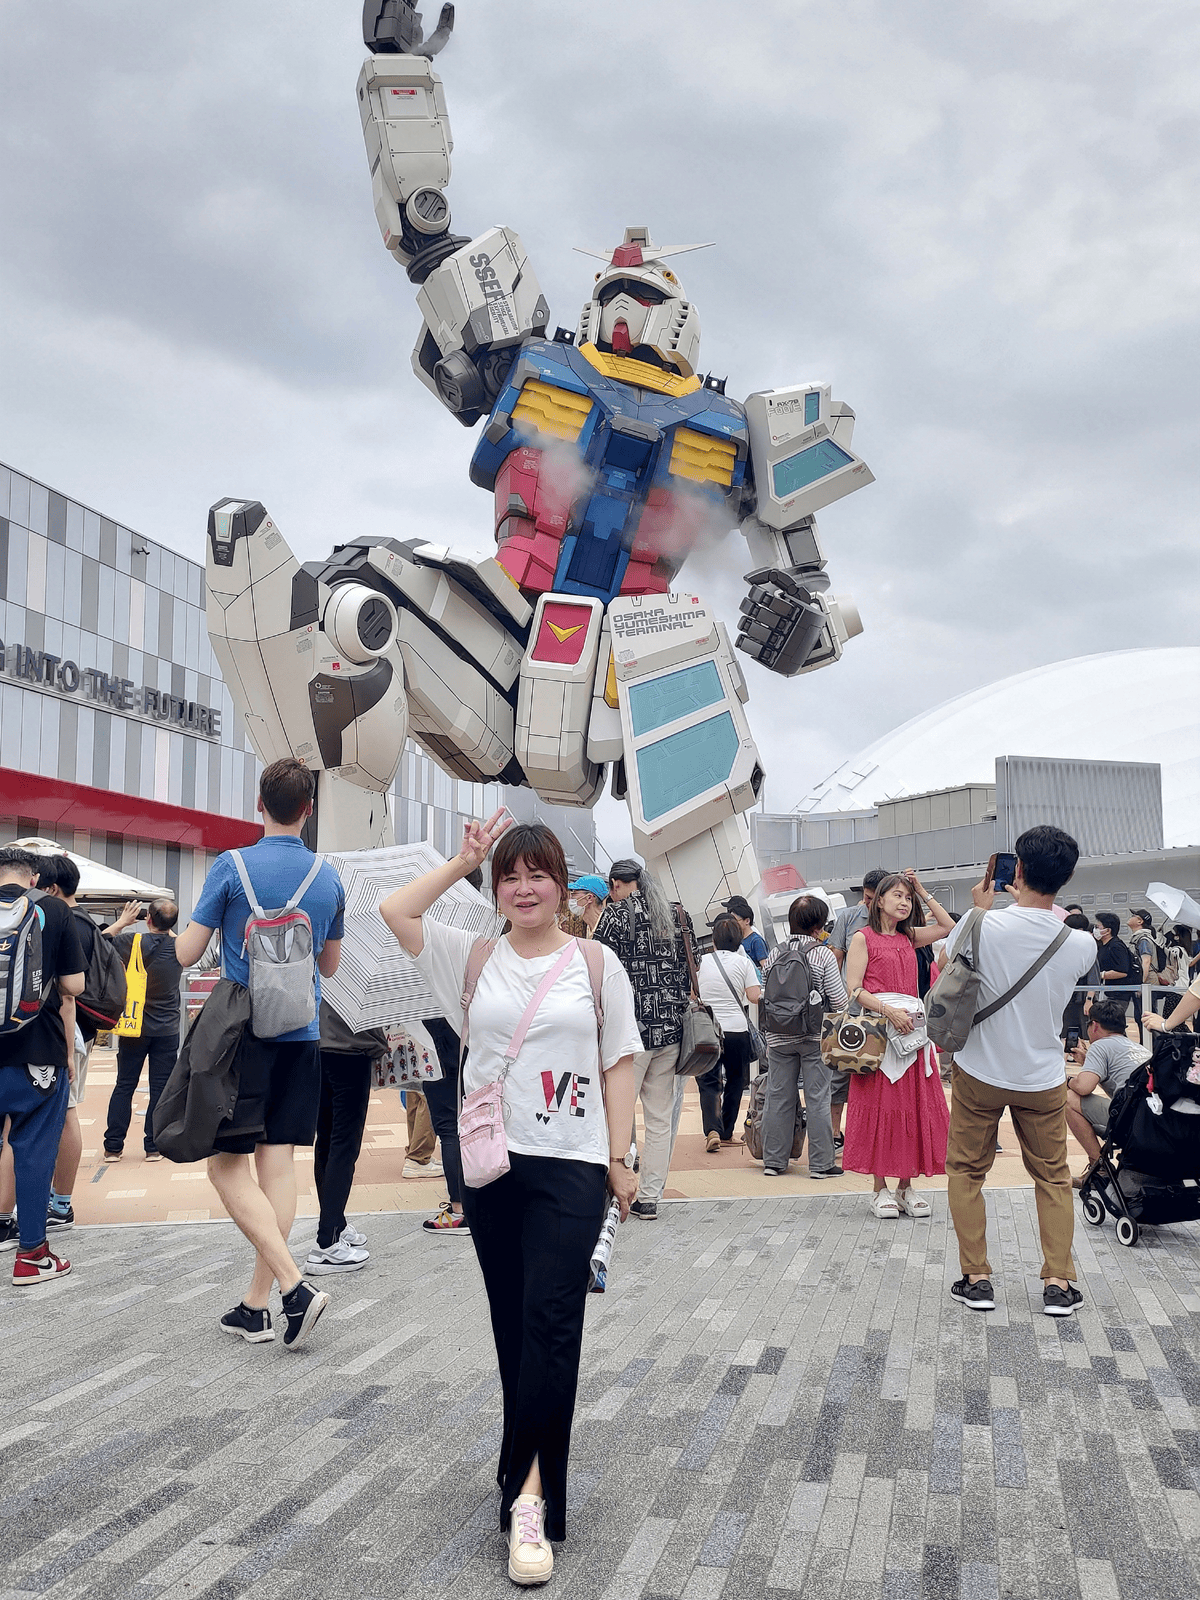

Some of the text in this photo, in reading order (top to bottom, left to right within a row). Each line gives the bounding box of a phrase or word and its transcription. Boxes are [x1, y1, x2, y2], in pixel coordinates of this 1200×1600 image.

[613, 608, 665, 623] OSAKA
[614, 610, 706, 631] YUMESHIMA
[615, 621, 694, 638] TERMINAL
[12, 643, 80, 692] INTO
[85, 667, 134, 710] THE
[143, 685, 221, 736] FUTURE
[540, 1070, 591, 1118] VE
